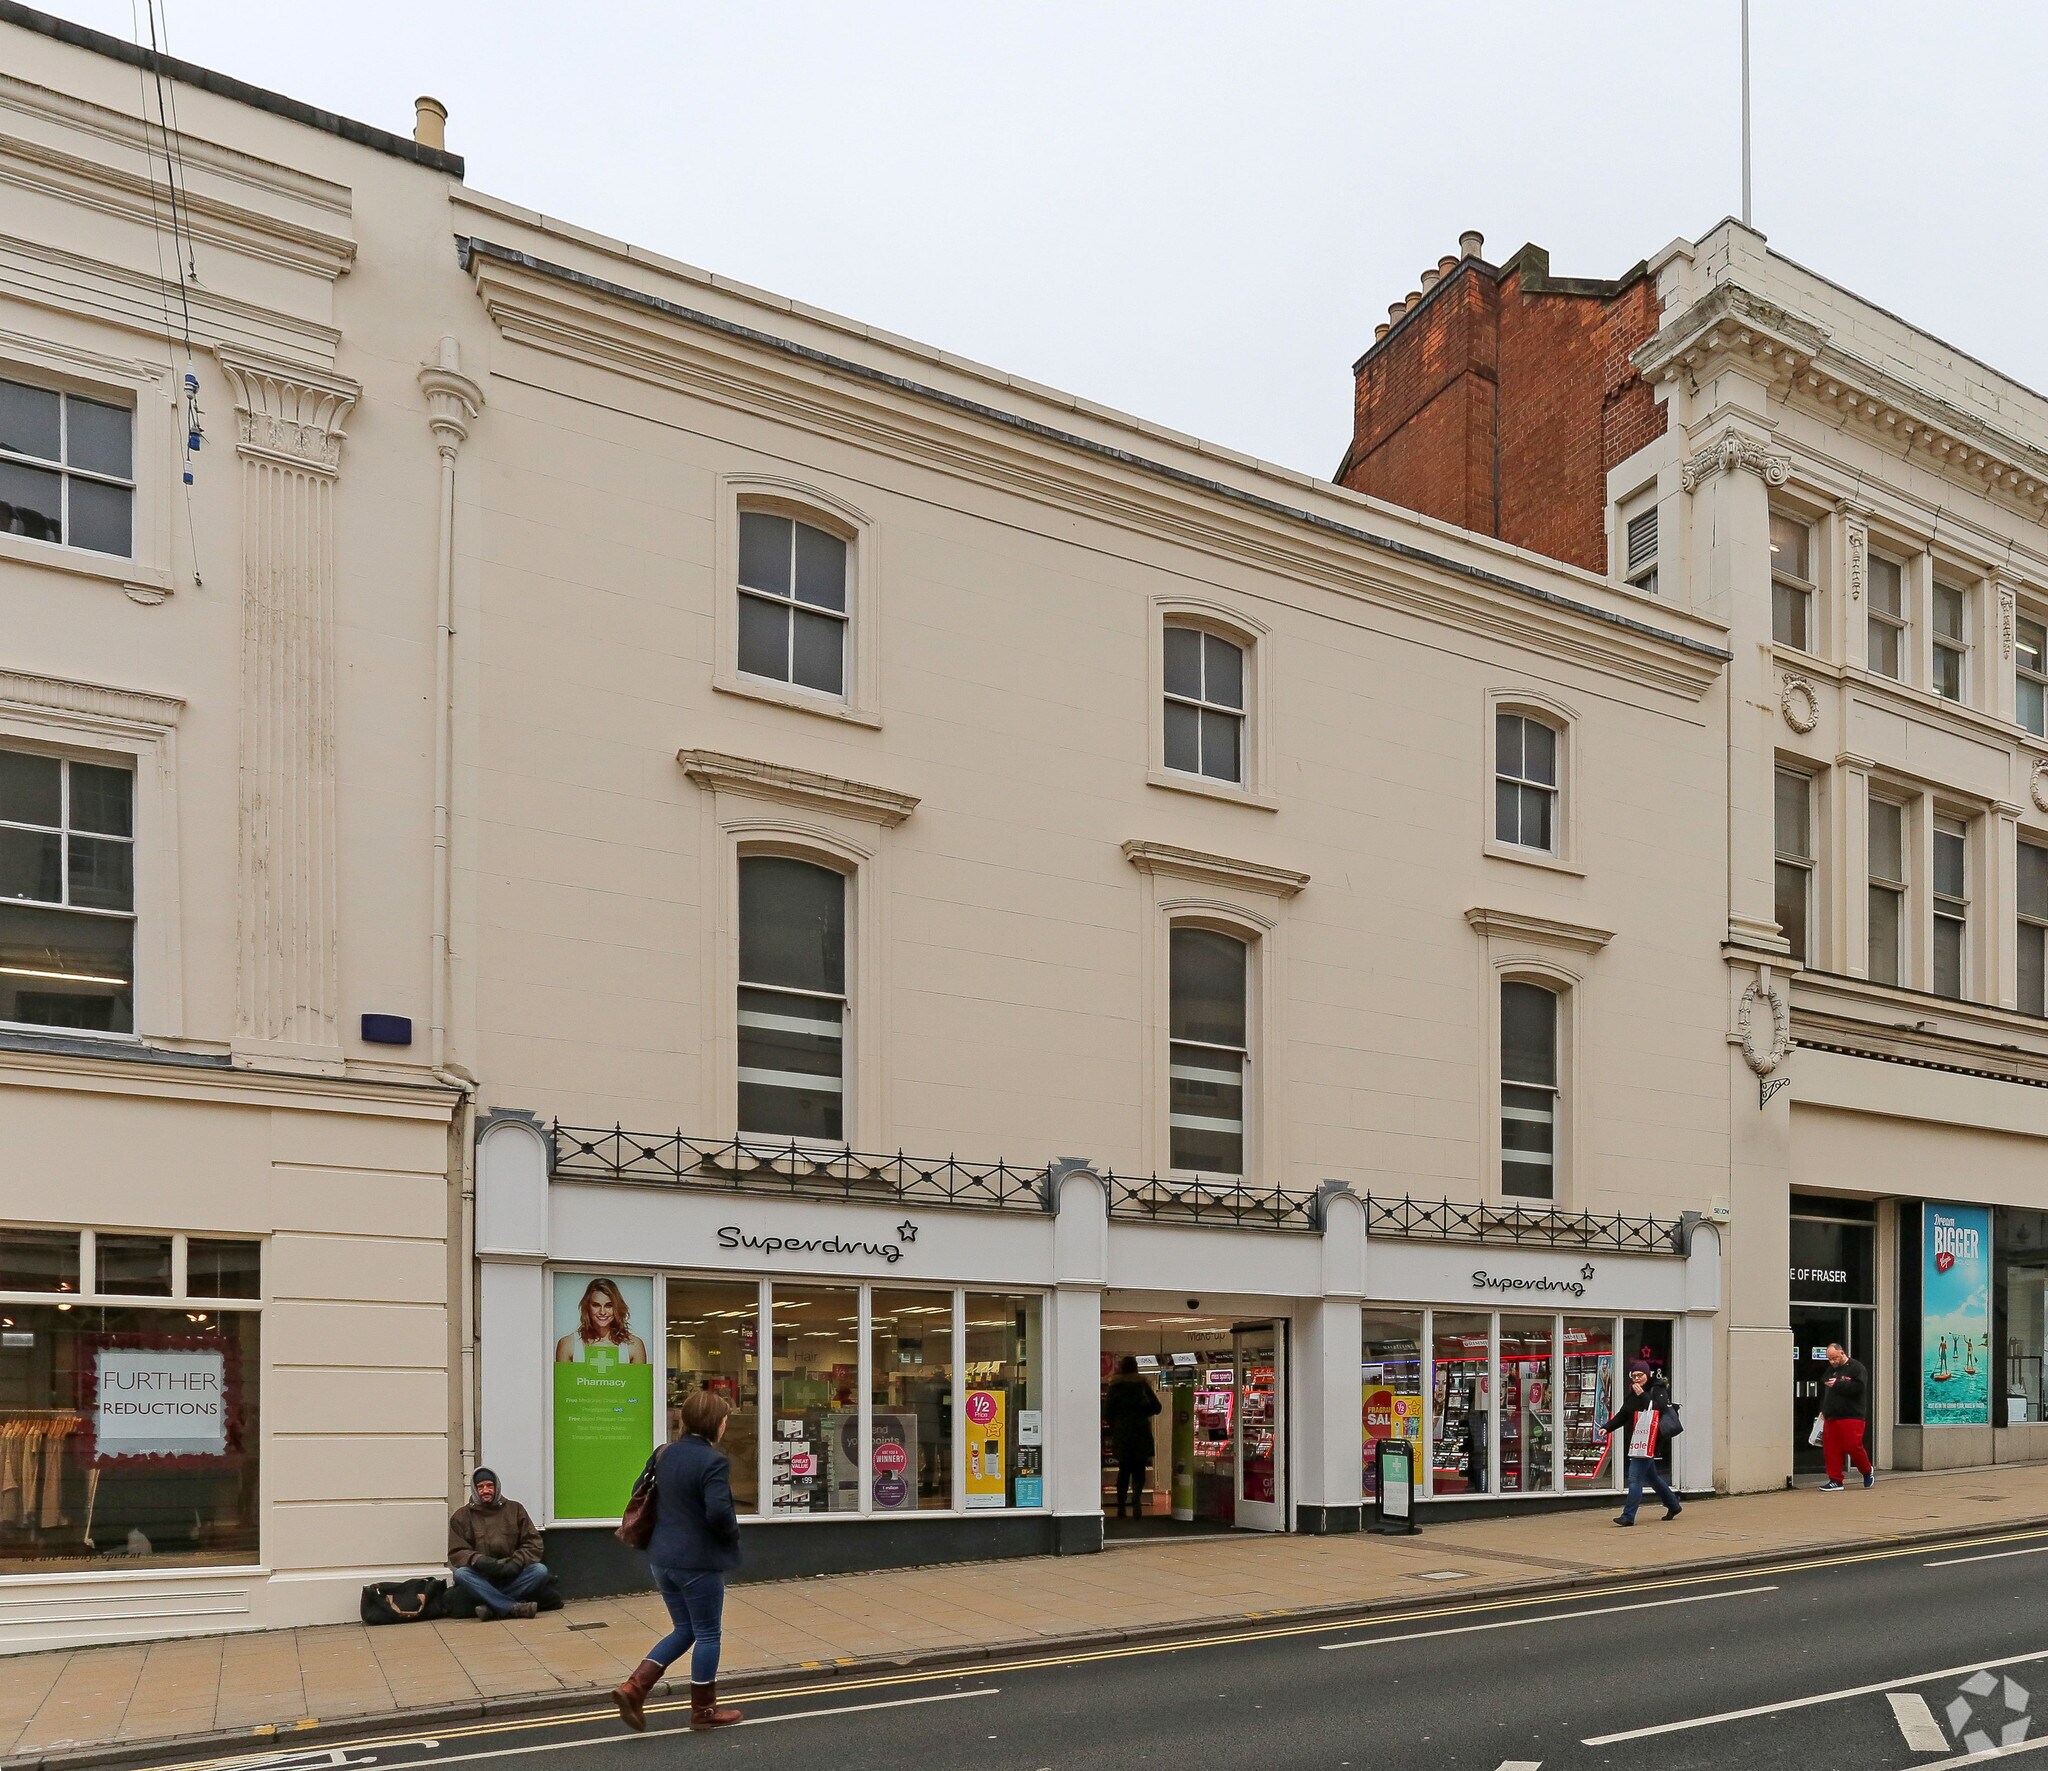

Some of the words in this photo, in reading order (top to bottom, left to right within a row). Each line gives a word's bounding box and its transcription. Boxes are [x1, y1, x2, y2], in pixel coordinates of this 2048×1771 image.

[1933, 1213, 1955, 1227] Dream
[717, 1226, 904, 1263] Superdrug
[1934, 1226, 1979, 1259] BIGGER
[1797, 1268, 1810, 1281] OF
[1811, 1269, 1847, 1283] FRASER
[1472, 1270, 1586, 1297] Superdrug
[794, 1350, 818, 1362] Hair
[104, 1371, 218, 1391] FURTHER
[576, 1377, 627, 1387] Pharmacy
[103, 1402, 217, 1415] REDUCTIONS
[972, 1396, 990, 1412] 1/2
[1367, 1413, 1391, 1426] SAL
[1630, 1441, 1647, 1450] sale
[876, 1455, 904, 1463] WINNER?
